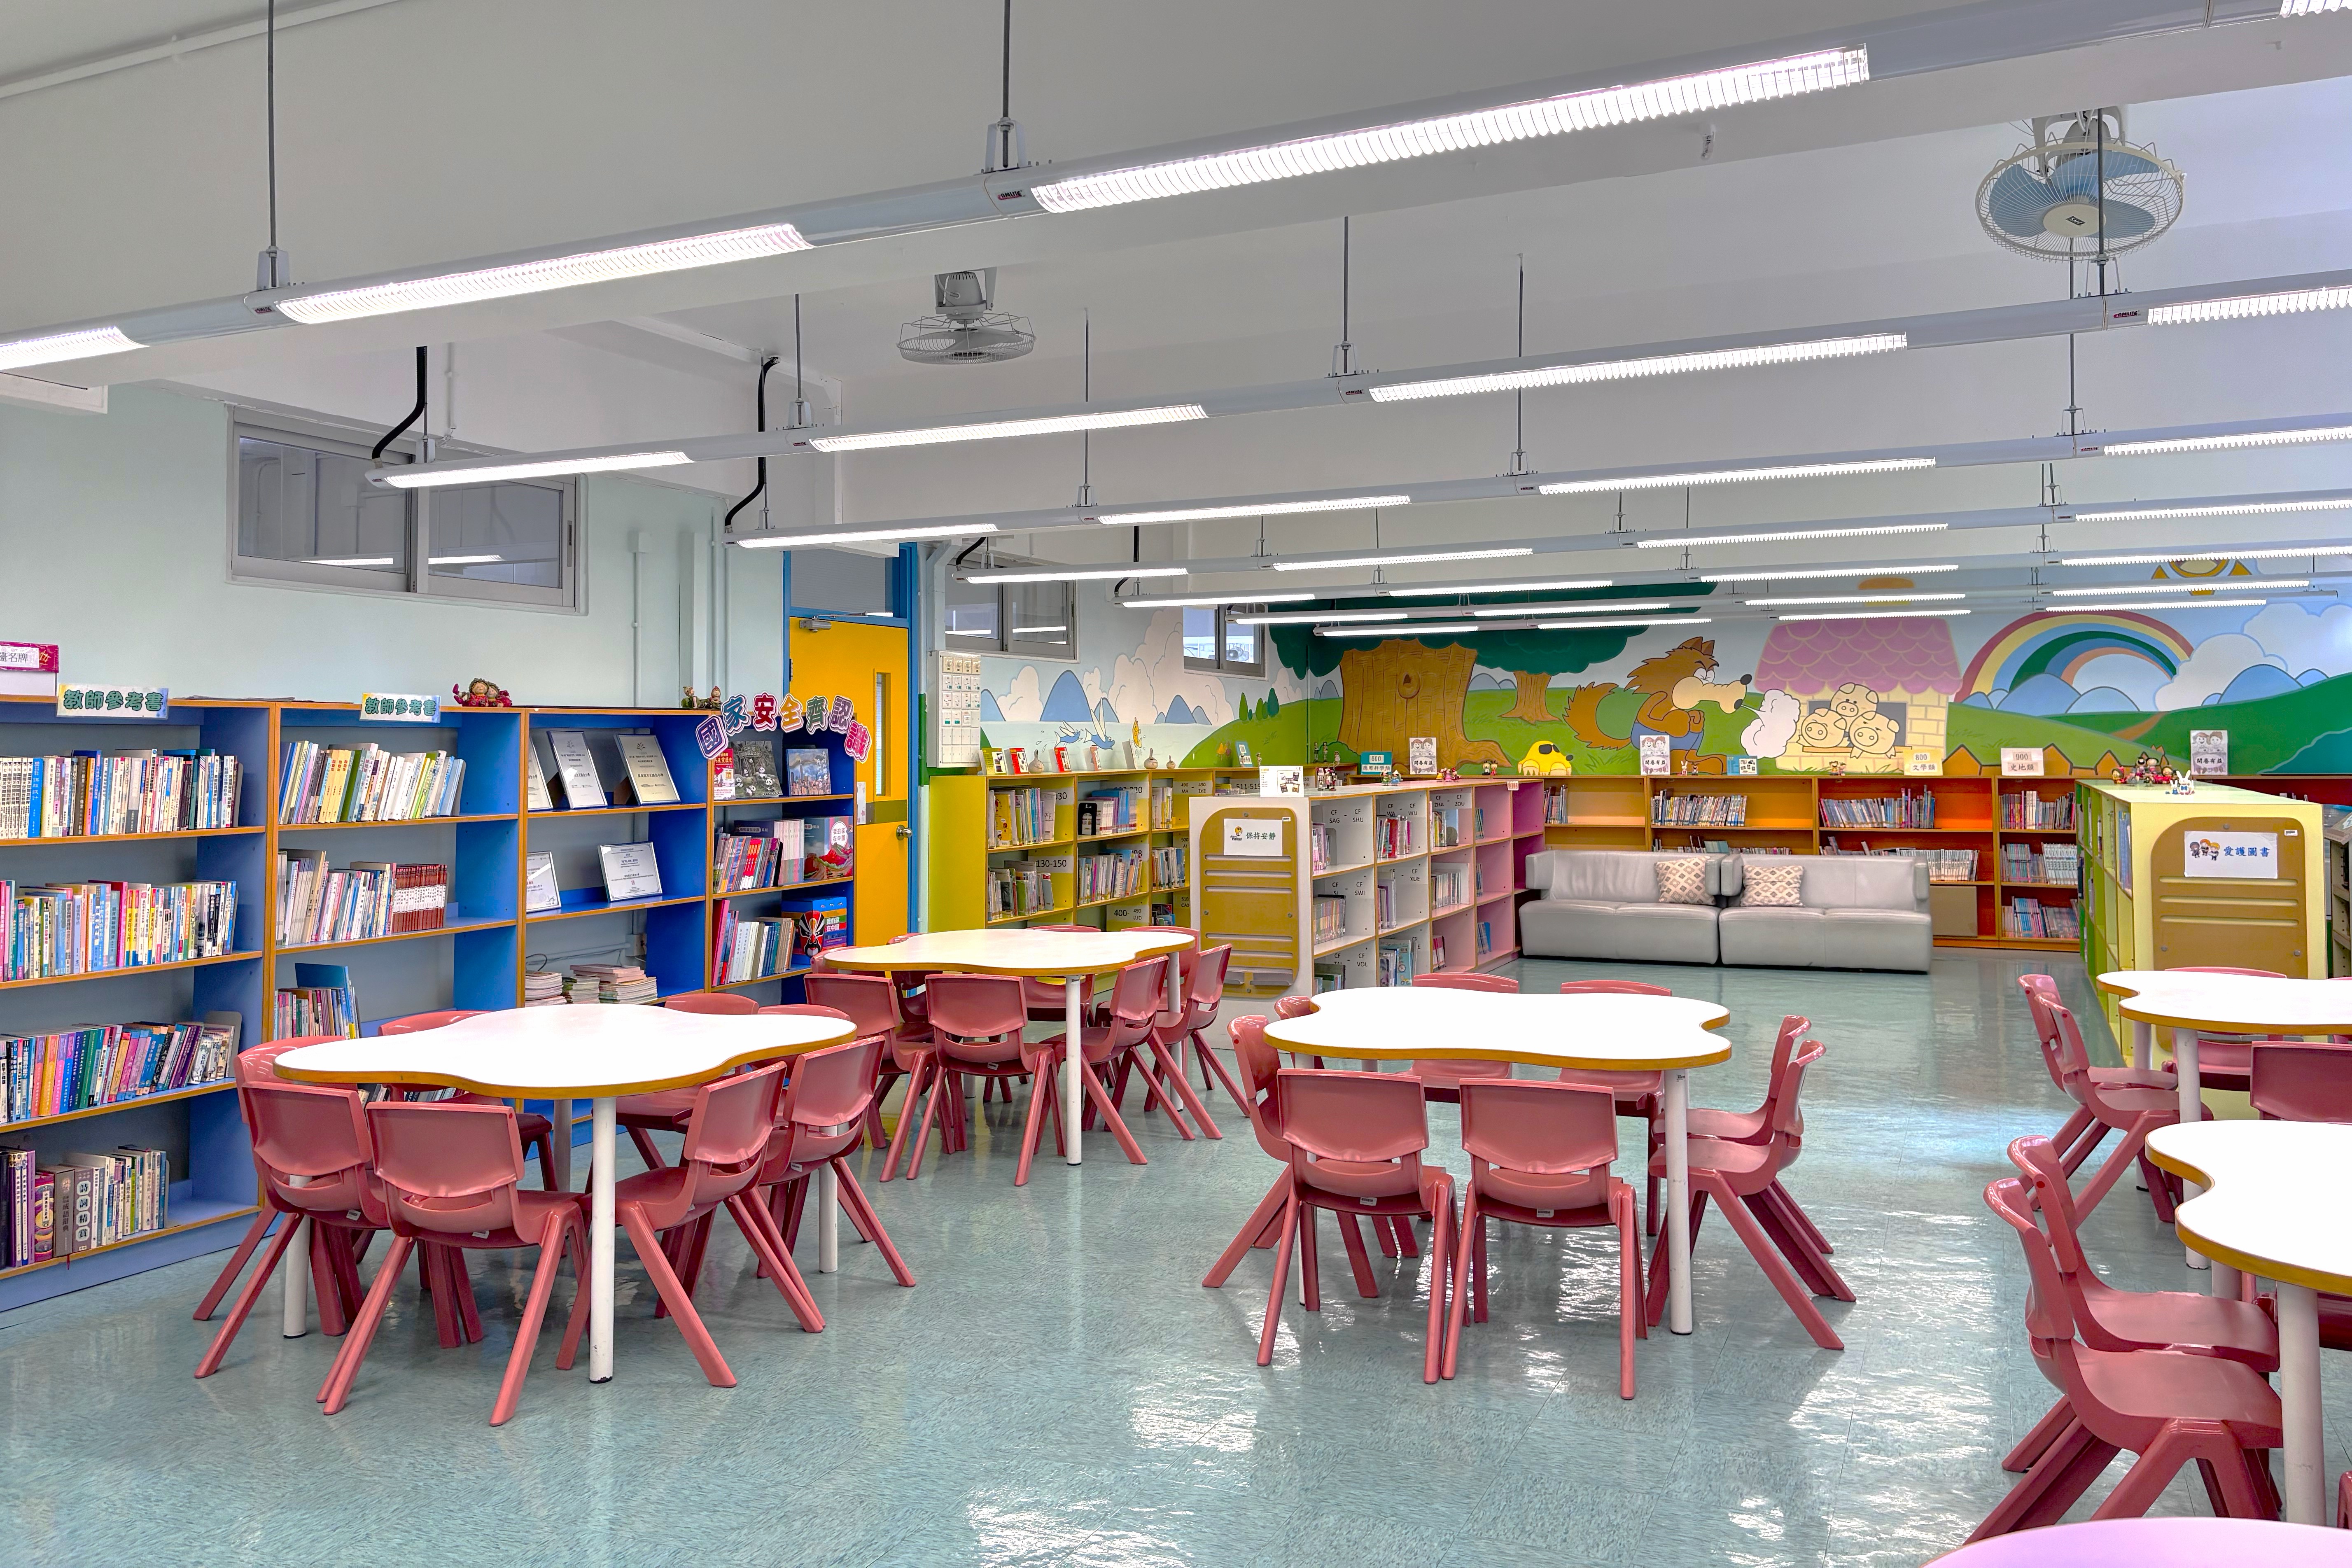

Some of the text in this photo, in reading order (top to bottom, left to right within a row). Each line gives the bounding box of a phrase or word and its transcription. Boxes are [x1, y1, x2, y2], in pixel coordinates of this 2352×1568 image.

[999, 191, 1022, 200] AMLITE
[2070, 217, 2082, 226] SMC
[63, 690, 164, 711] 教師參考書
[365, 697, 436, 716] 教師參考書
[697, 692, 871, 762] 國家安全齊認識
[1246, 832, 1276, 840] 保持安靜
[2224, 846, 2270, 857] 愛護圖書
[1036, 859, 1066, 868] 130-150
